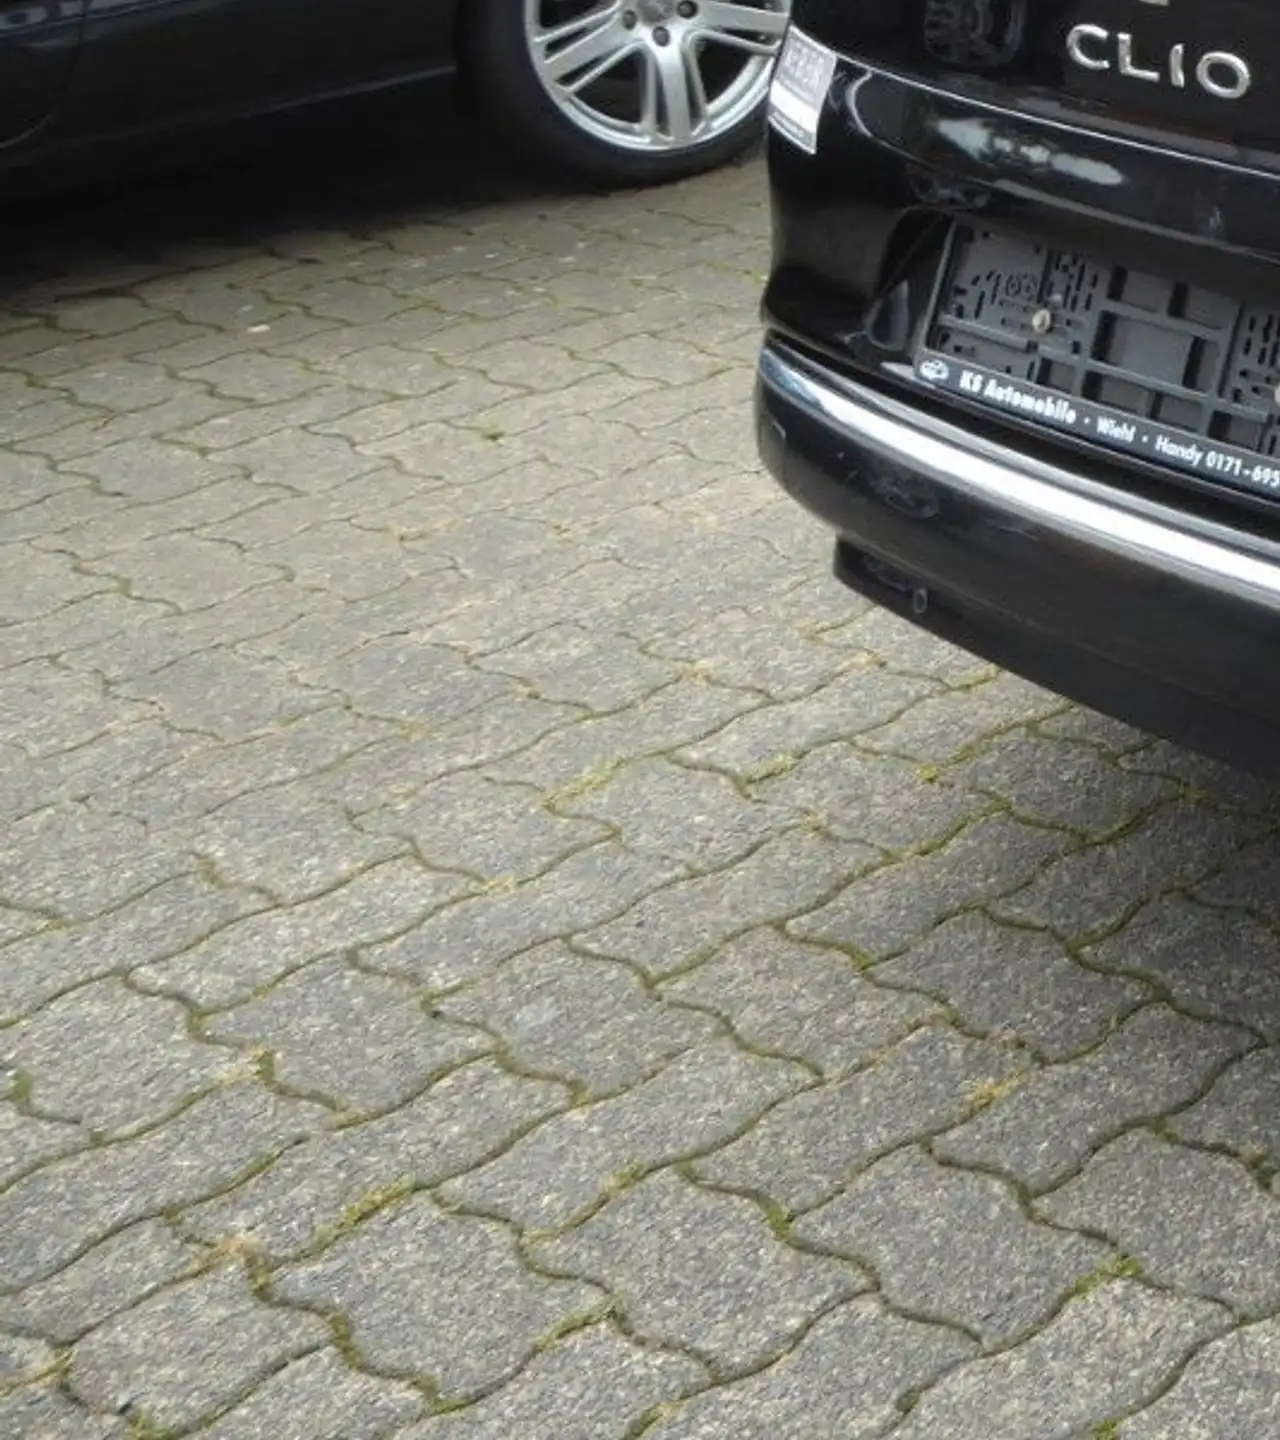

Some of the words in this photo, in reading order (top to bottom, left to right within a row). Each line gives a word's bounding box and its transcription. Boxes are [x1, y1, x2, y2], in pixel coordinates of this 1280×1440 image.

[1066, 23, 1251, 100] CLIO
[960, 369, 983, 393] KS
[984, 379, 1076, 424] Automobile
[1155, 433, 1203, 468] Handy
